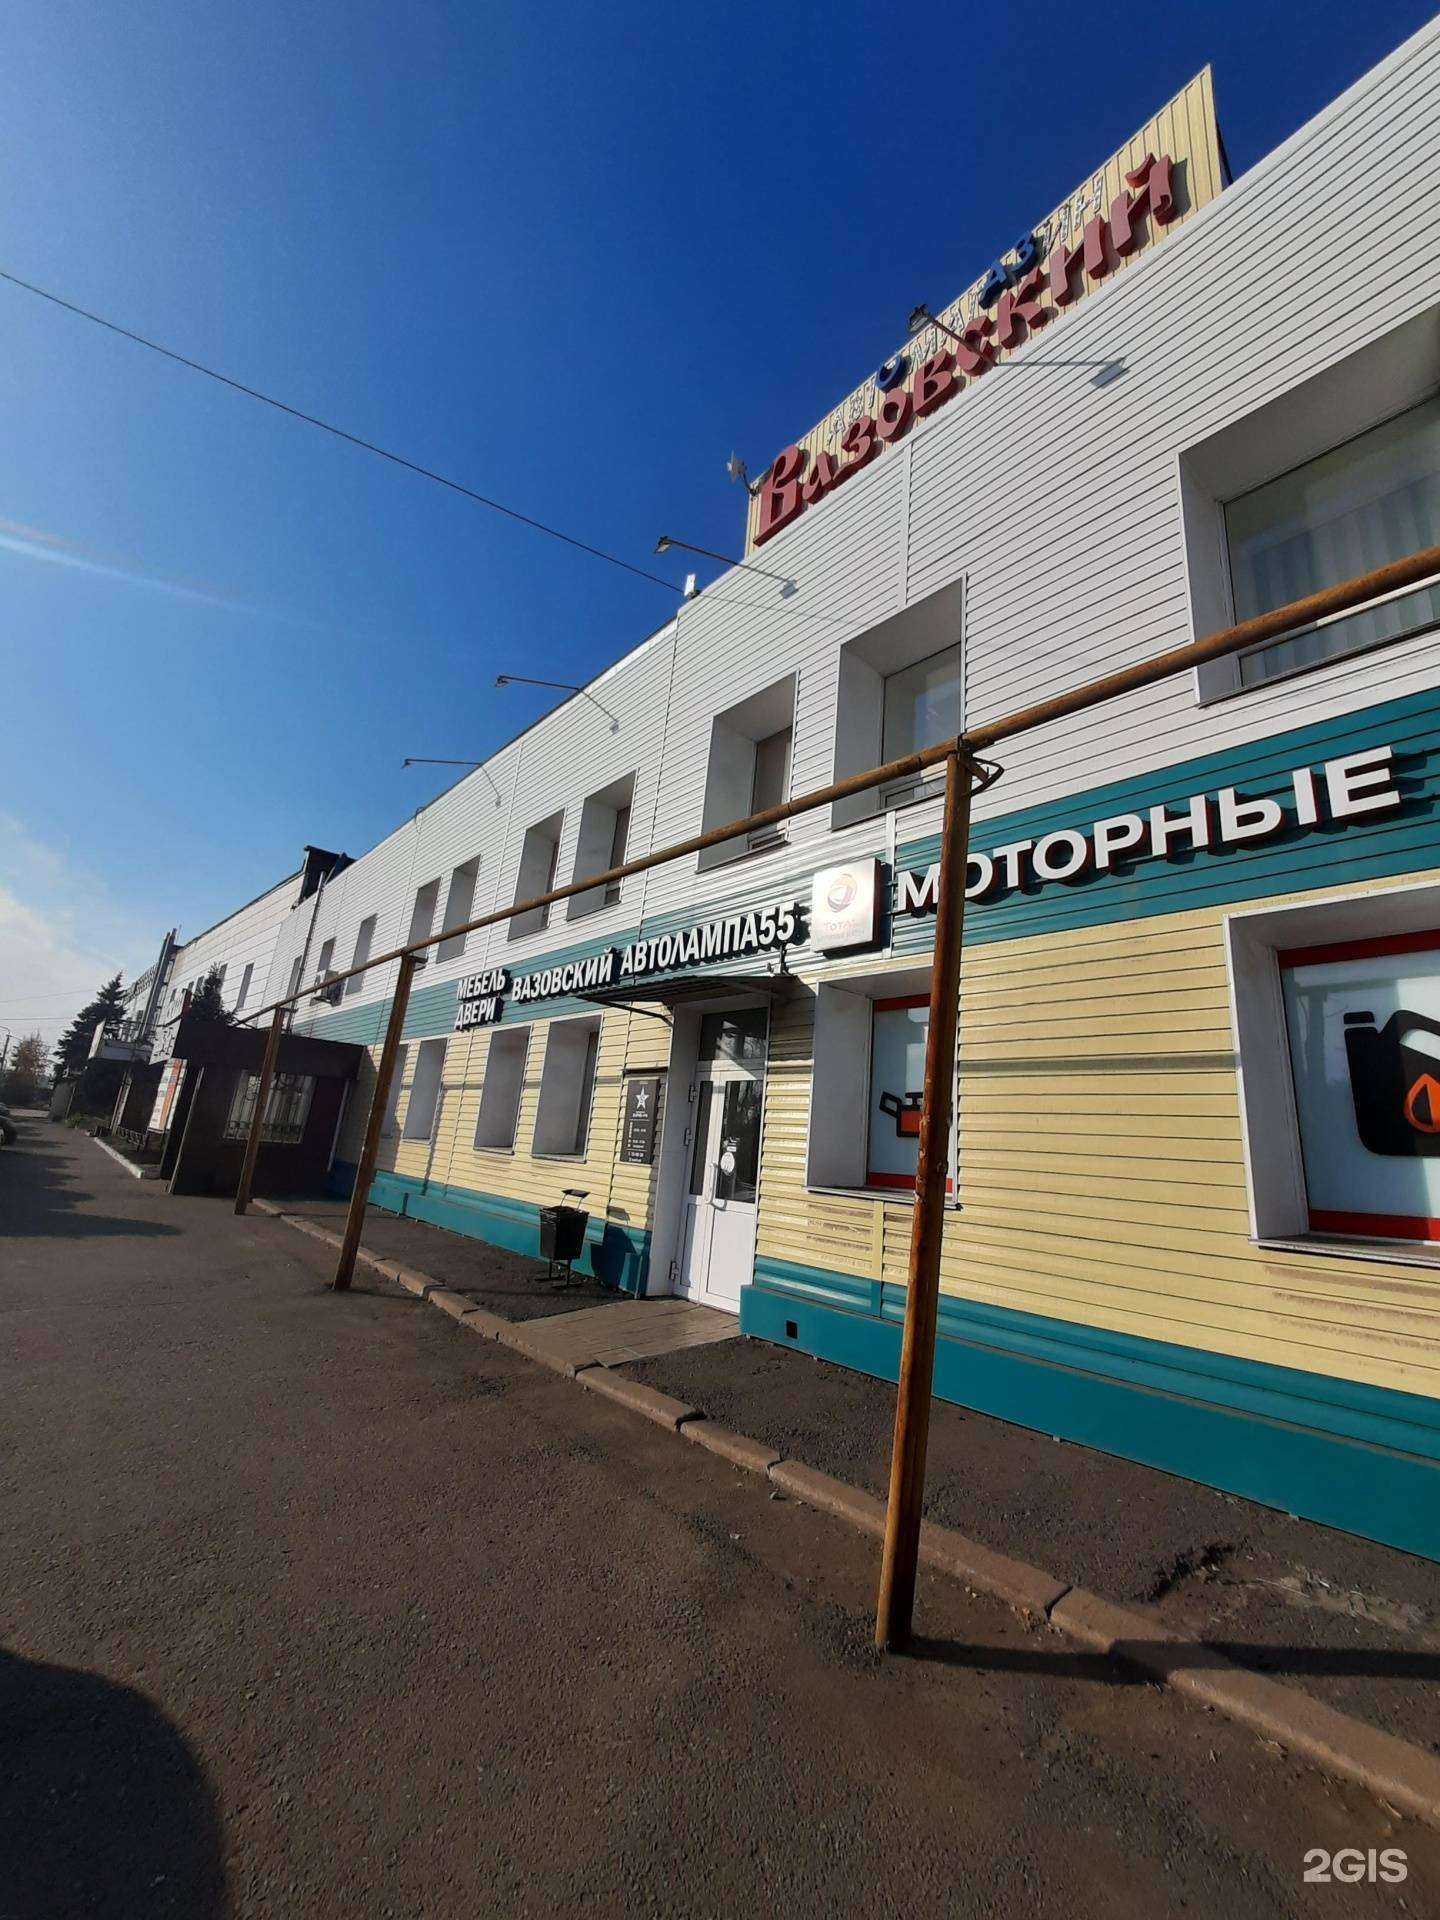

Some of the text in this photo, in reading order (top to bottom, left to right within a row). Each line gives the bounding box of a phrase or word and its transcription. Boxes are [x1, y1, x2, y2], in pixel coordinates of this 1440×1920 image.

[898, 745, 1401, 911] МОТОРНЫЕ
[456, 968, 506, 1000] МЕБЕЛЬ
[511, 904, 797, 1002] ВАЗОВСКИЙ АВТОЛАМПА55
[454, 997, 496, 1030] ДВЕРИ
